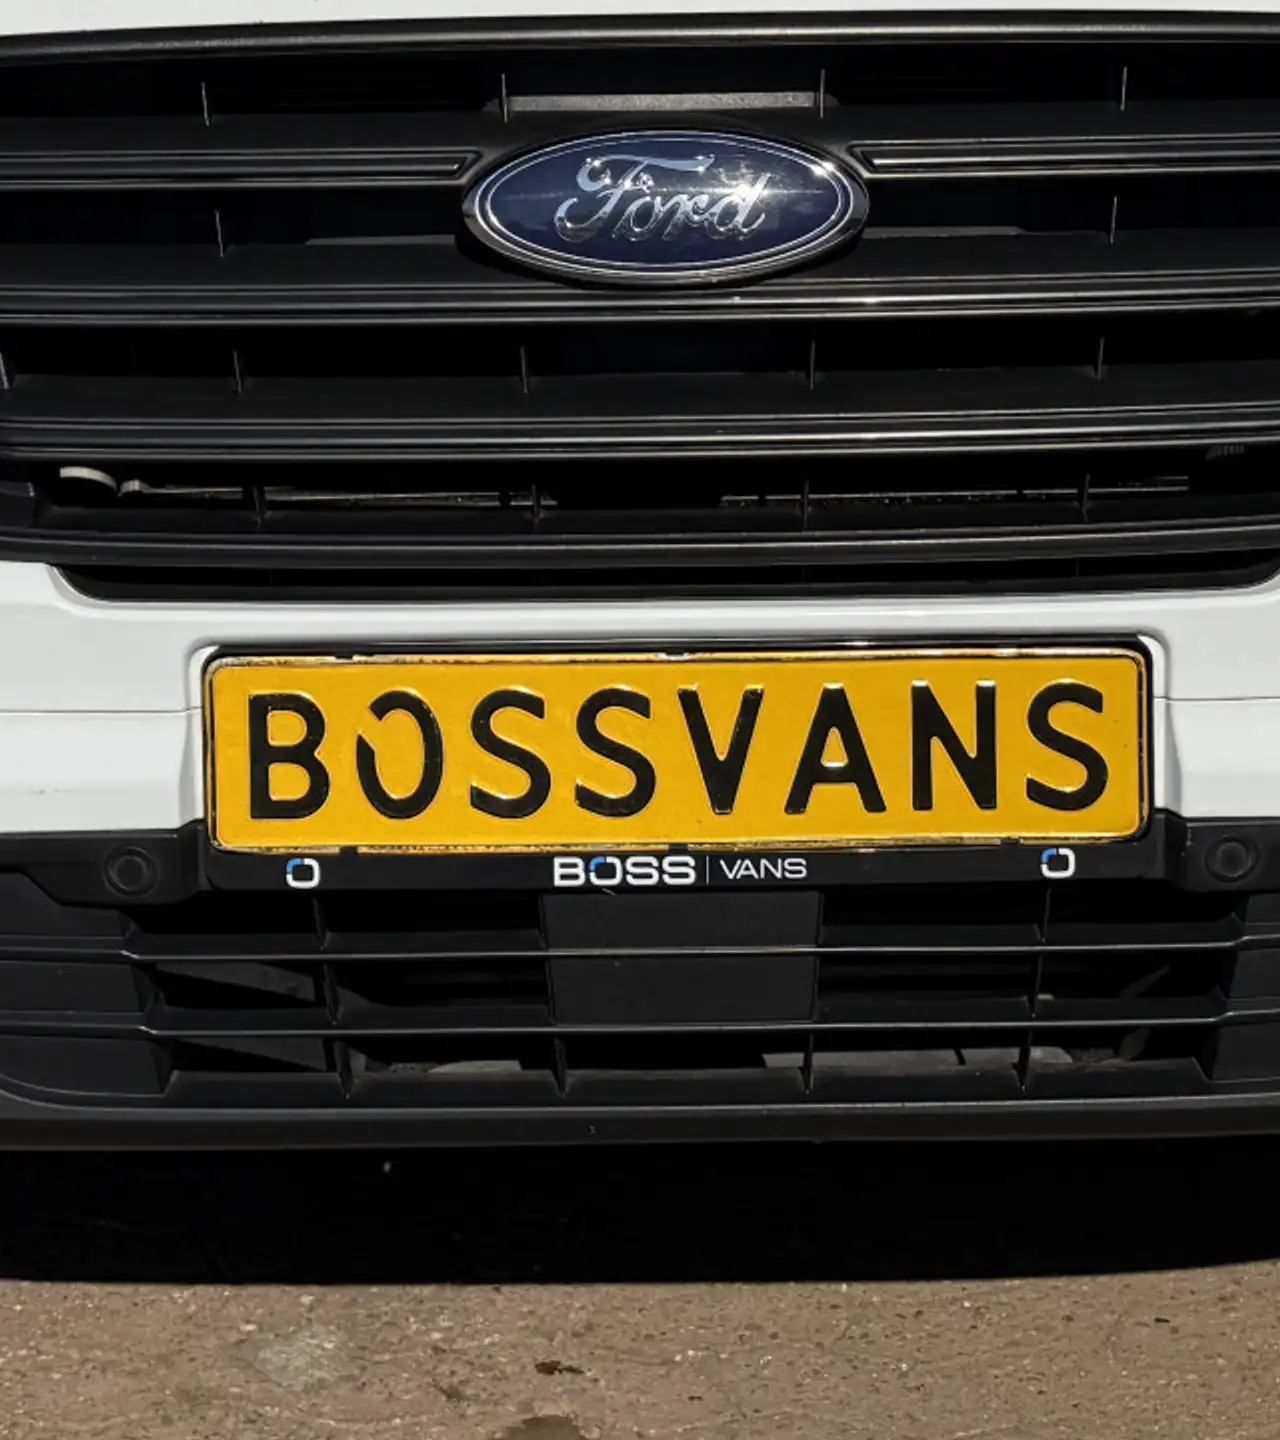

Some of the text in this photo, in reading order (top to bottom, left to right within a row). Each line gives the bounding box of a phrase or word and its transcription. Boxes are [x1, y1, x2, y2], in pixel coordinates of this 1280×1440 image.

[553, 152, 771, 243] Ford
[247, 677, 1111, 822] BOSSVANS
[553, 854, 809, 887] BOSS VANS
